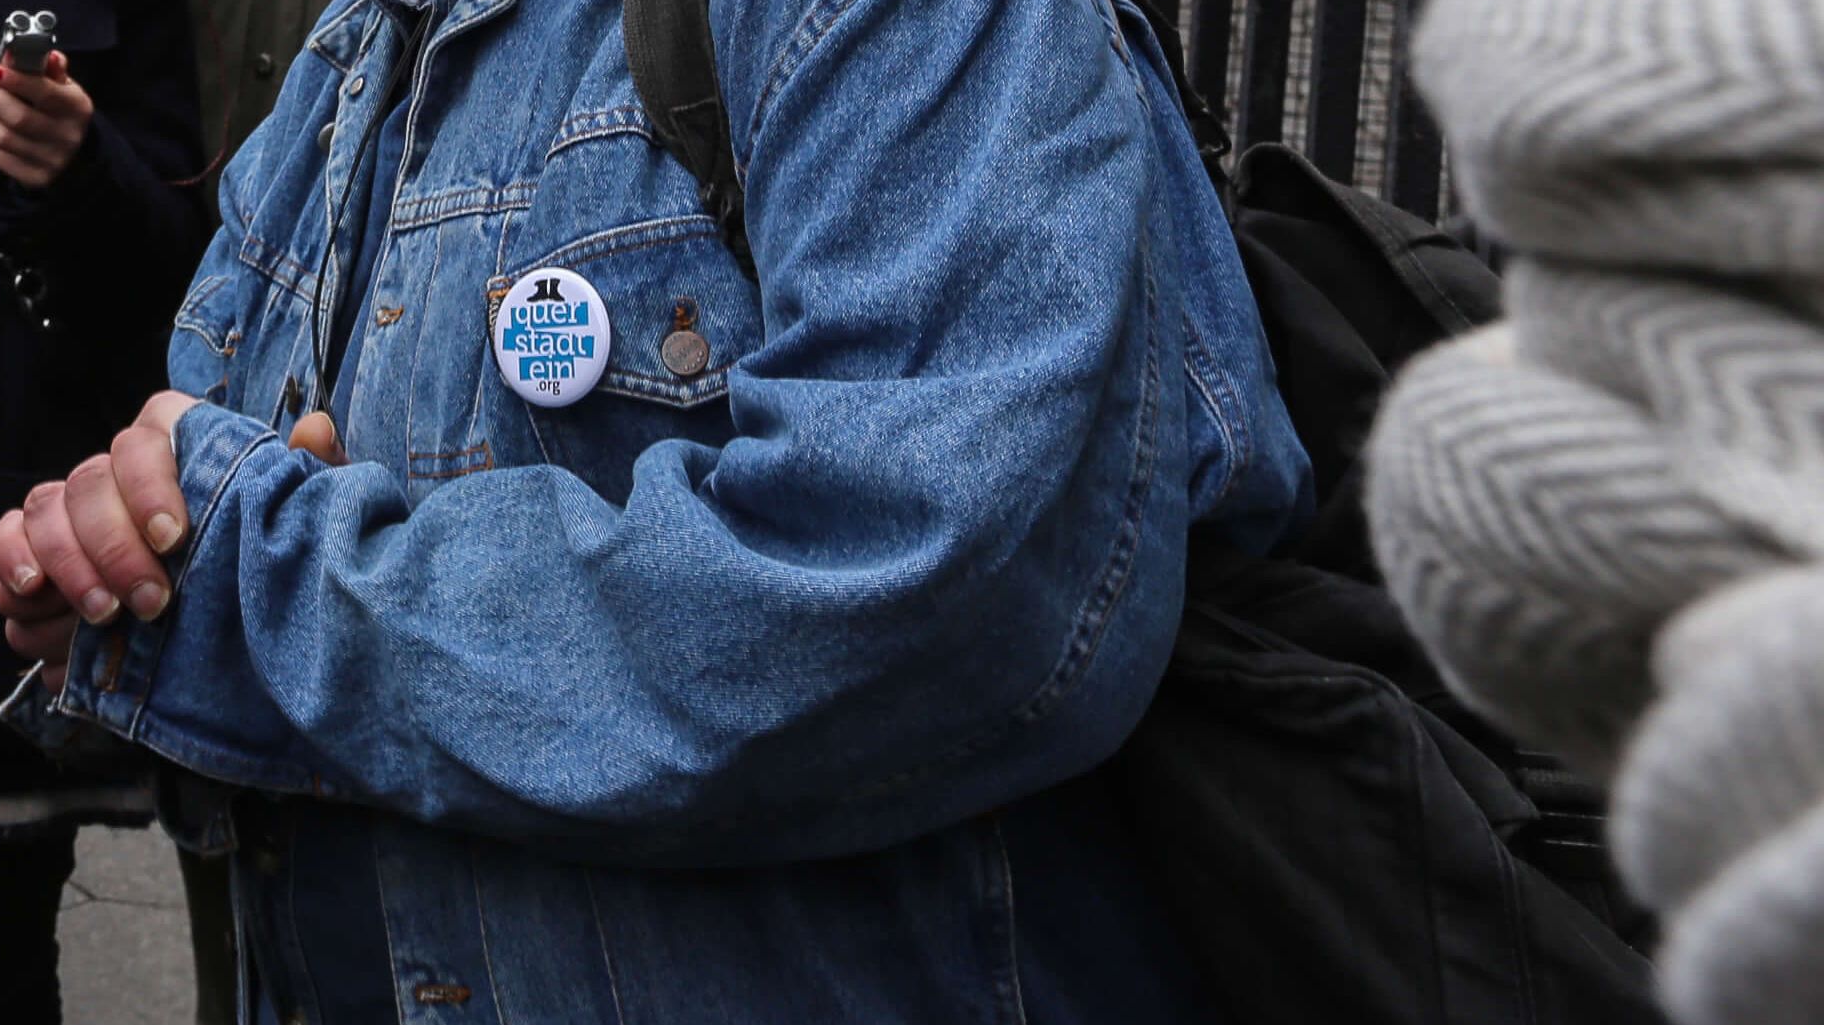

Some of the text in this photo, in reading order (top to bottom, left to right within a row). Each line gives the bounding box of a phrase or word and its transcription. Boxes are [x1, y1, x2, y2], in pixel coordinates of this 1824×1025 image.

[516, 301, 581, 331] quer
[515, 328, 587, 356] stadt
[529, 355, 574, 380] ein
[536, 381, 561, 395] .org
